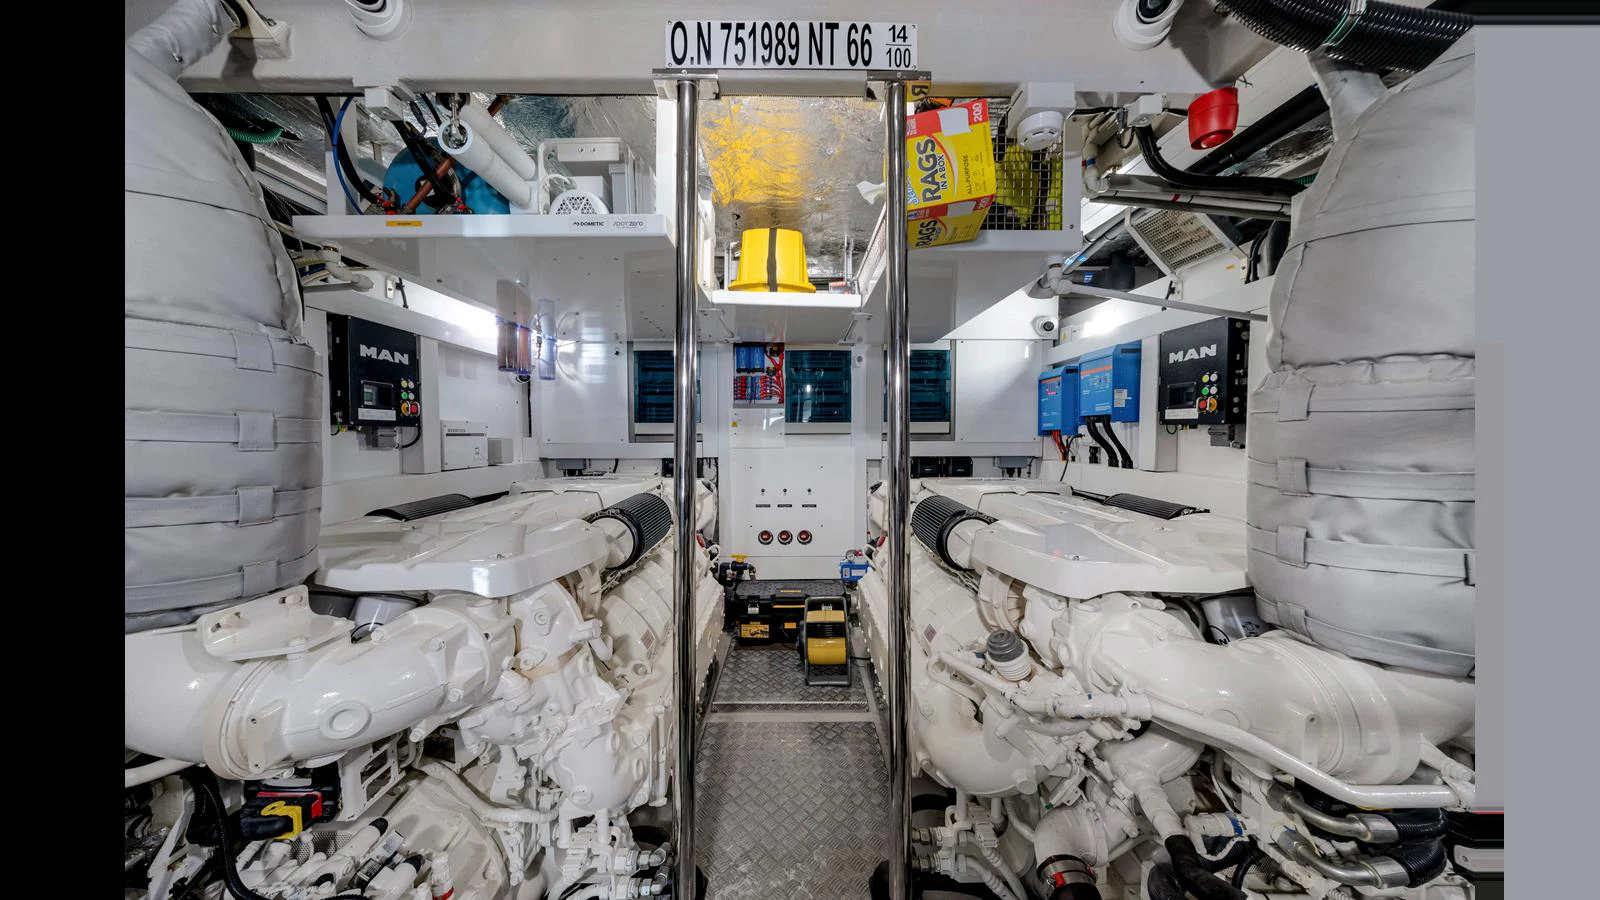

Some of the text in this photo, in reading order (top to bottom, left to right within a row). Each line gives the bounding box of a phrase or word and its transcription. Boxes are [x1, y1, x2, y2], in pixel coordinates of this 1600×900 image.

[670, 21, 873, 67] O.N 751989 NT 66
[888, 24, 909, 43] 14
[886, 47, 912, 68] 100
[971, 102, 983, 123] 200
[915, 138, 942, 203] RAGS
[937, 154, 946, 172] BOX
[915, 219, 938, 248] RAGS
[359, 343, 409, 365] MAN
[1168, 343, 1217, 364] MAN
